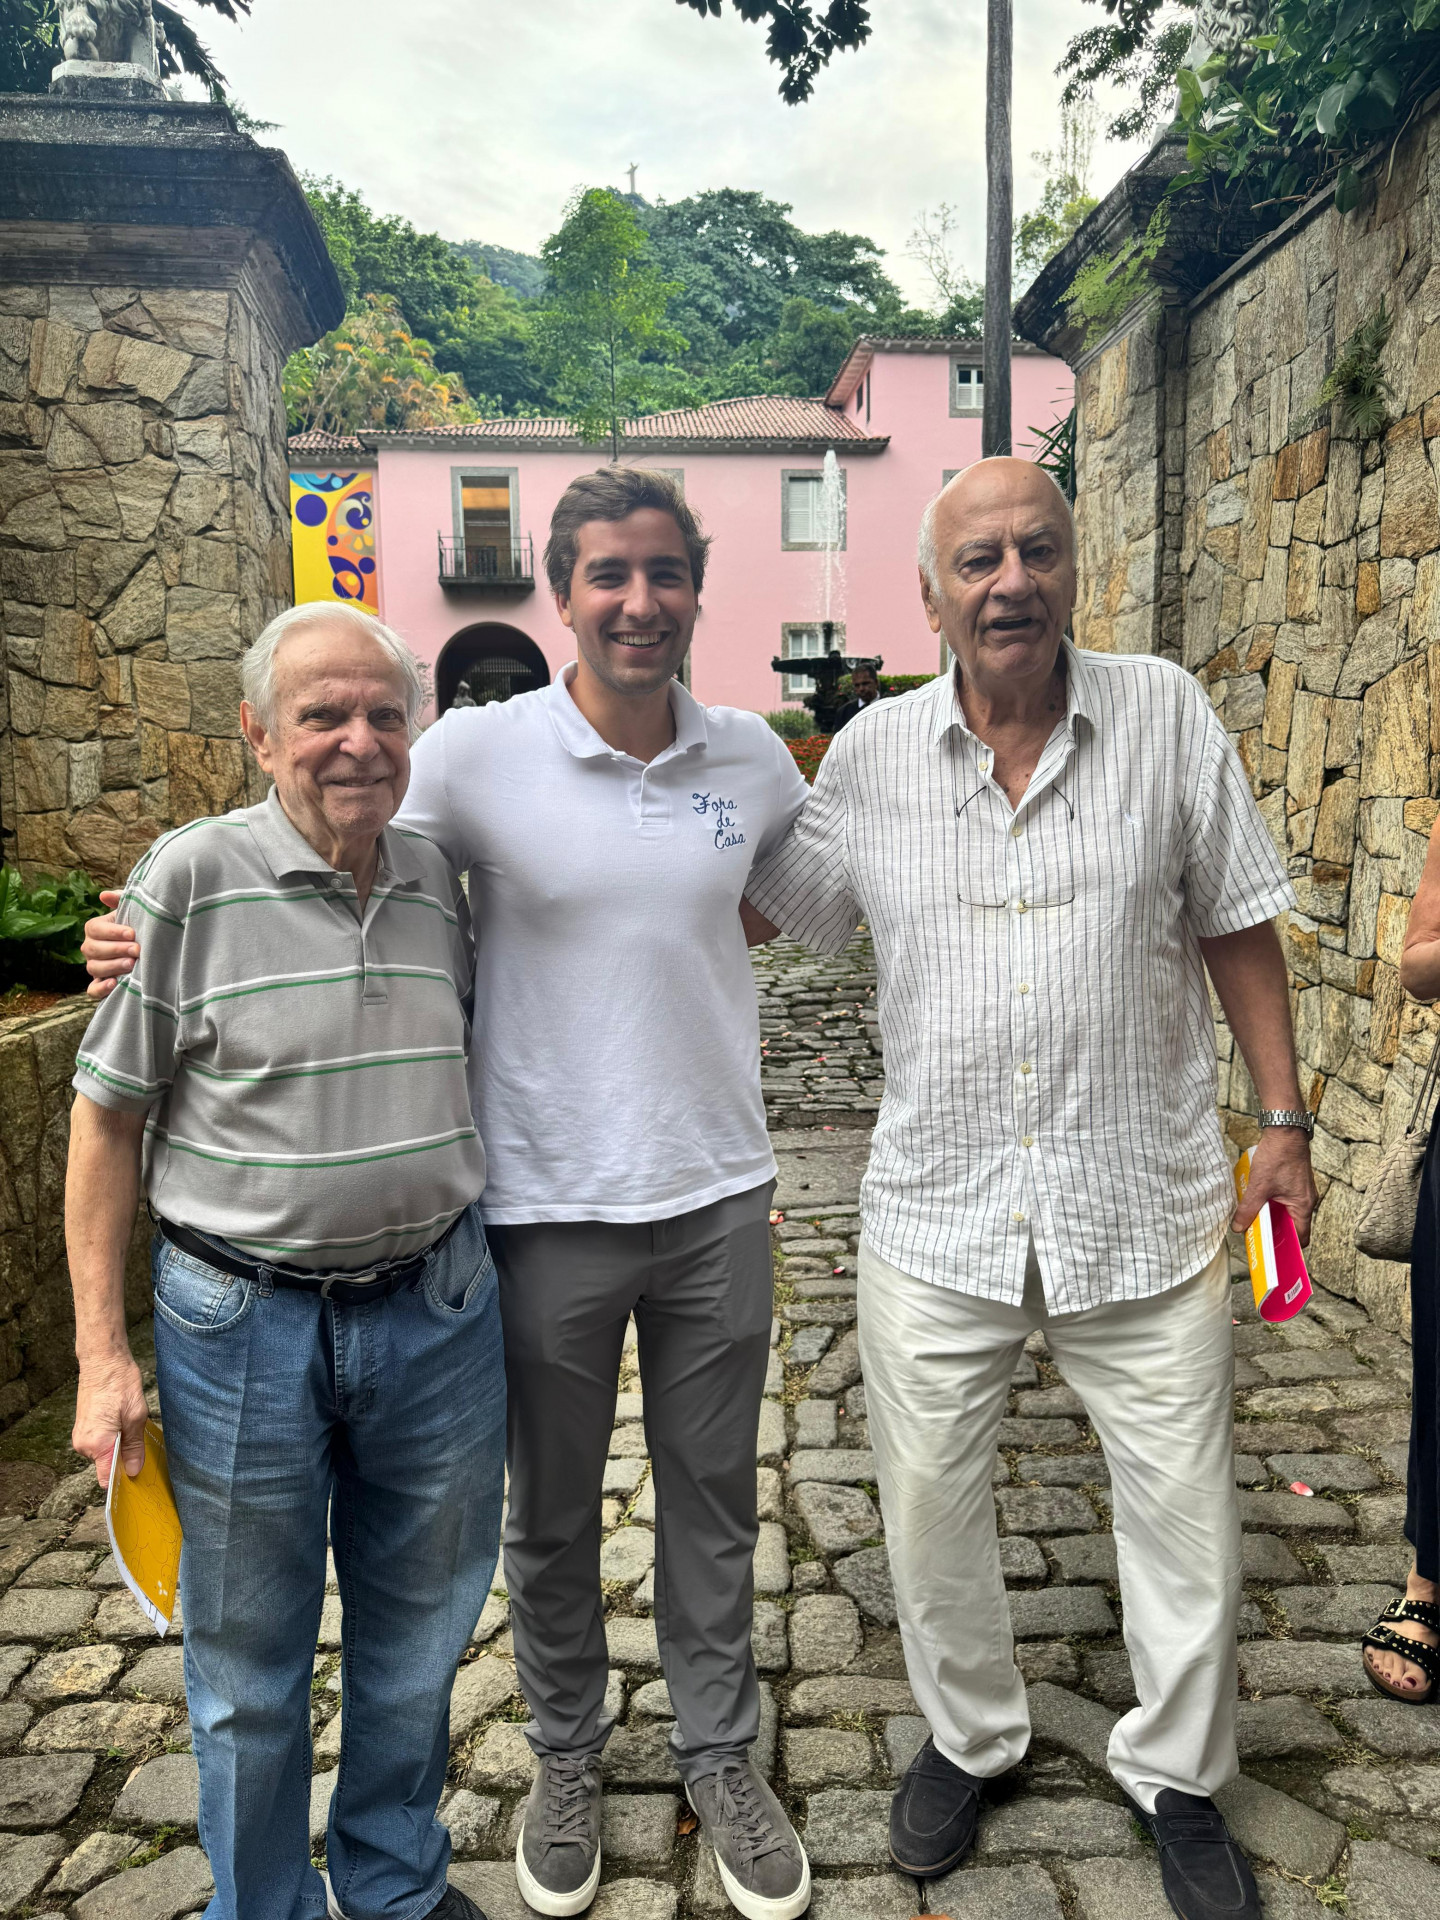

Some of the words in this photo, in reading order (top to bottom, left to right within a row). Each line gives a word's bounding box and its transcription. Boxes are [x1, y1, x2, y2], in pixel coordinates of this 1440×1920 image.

[692, 792, 738, 815] Fora
[716, 809, 735, 828] de
[714, 829, 746, 850] Casa
